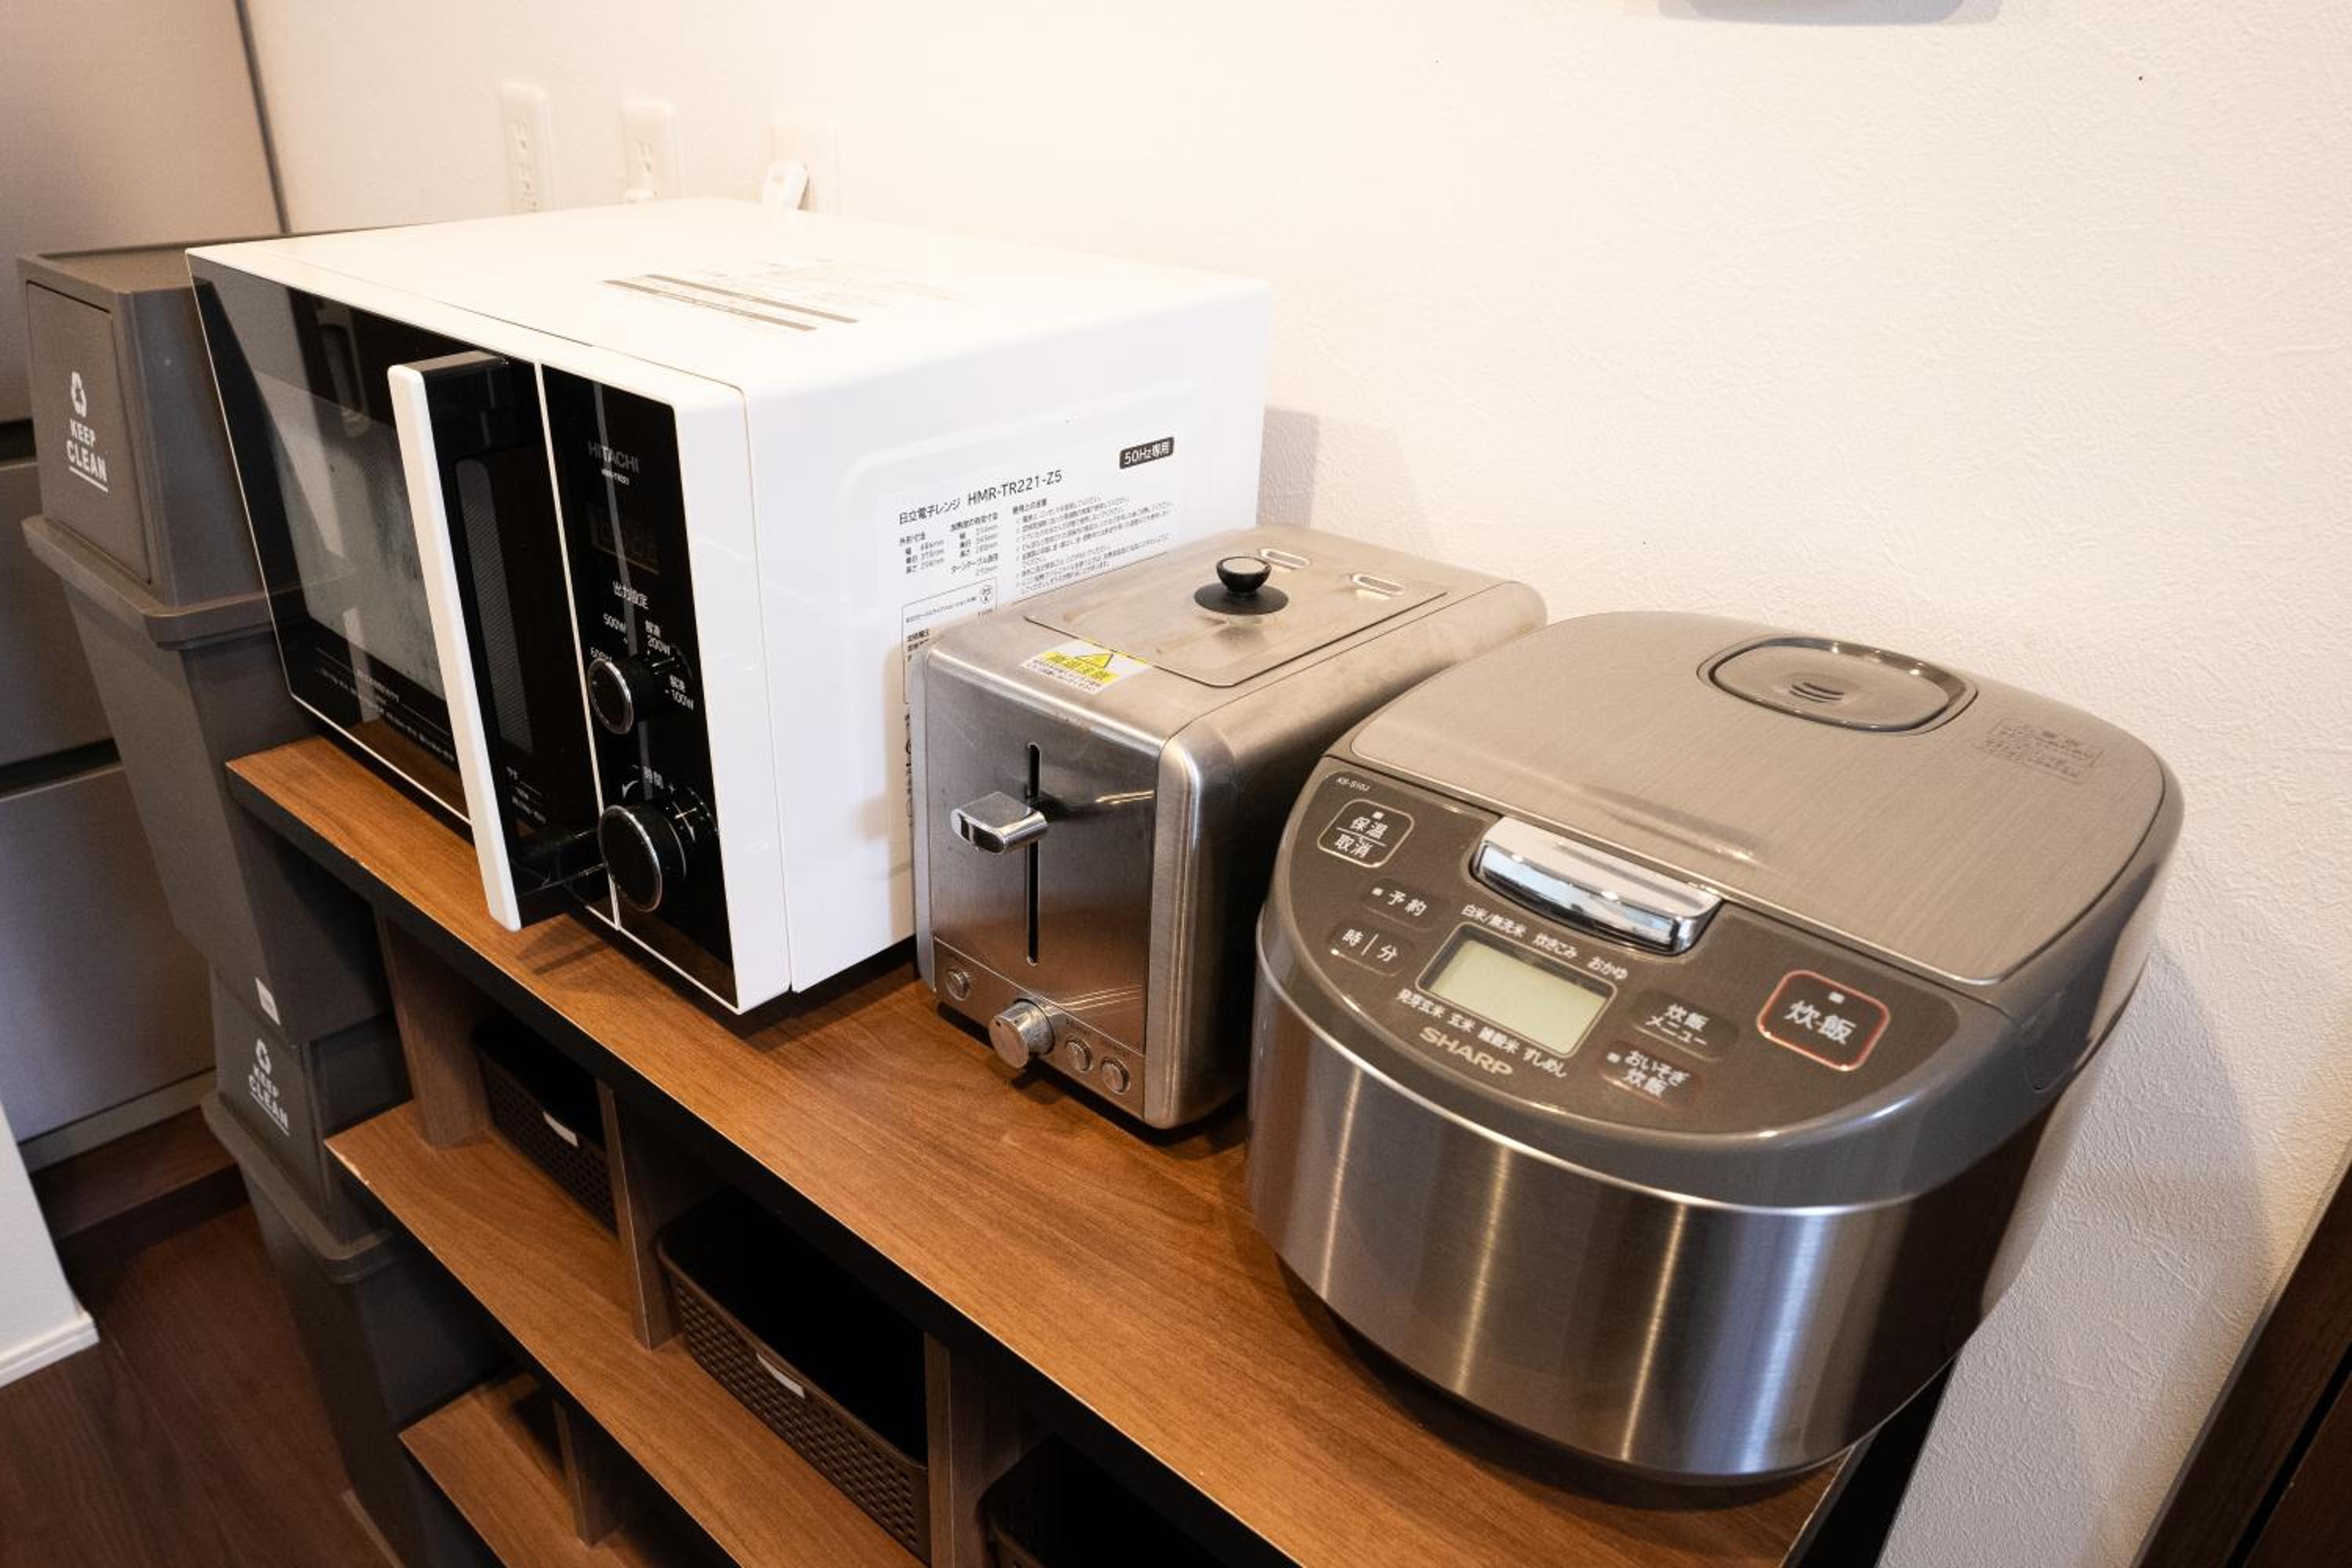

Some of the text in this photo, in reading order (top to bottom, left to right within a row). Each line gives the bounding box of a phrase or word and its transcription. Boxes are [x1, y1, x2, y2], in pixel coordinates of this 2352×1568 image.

[70, 418, 96, 448] KEEP
[67, 439, 107, 482] CLEAN
[587, 440, 639, 474] HITACHI
[1123, 441, 1171, 465] 50Hz専用
[898, 470, 1062, 524] 日立電子レンジ HMR-TR221-Z5
[1349, 816, 1388, 840] 保温
[1334, 833, 1374, 858] 取消
[1387, 890, 1427, 916] 予約
[1587, 956, 1628, 980] おかゆ
[1447, 1012, 1475, 1033] 玄米
[1645, 1015, 1708, 1045] メニュー
[1663, 1004, 1710, 1033] 炊飯
[1783, 1000, 1857, 1045] 炊飯
[1419, 1025, 1514, 1076] SHARP
[252, 1063, 279, 1098] KEEP
[1621, 1067, 1670, 1099] 炊飯
[1624, 1050, 1691, 1087] おいそぎ
[249, 1074, 289, 1130] CLEAN
